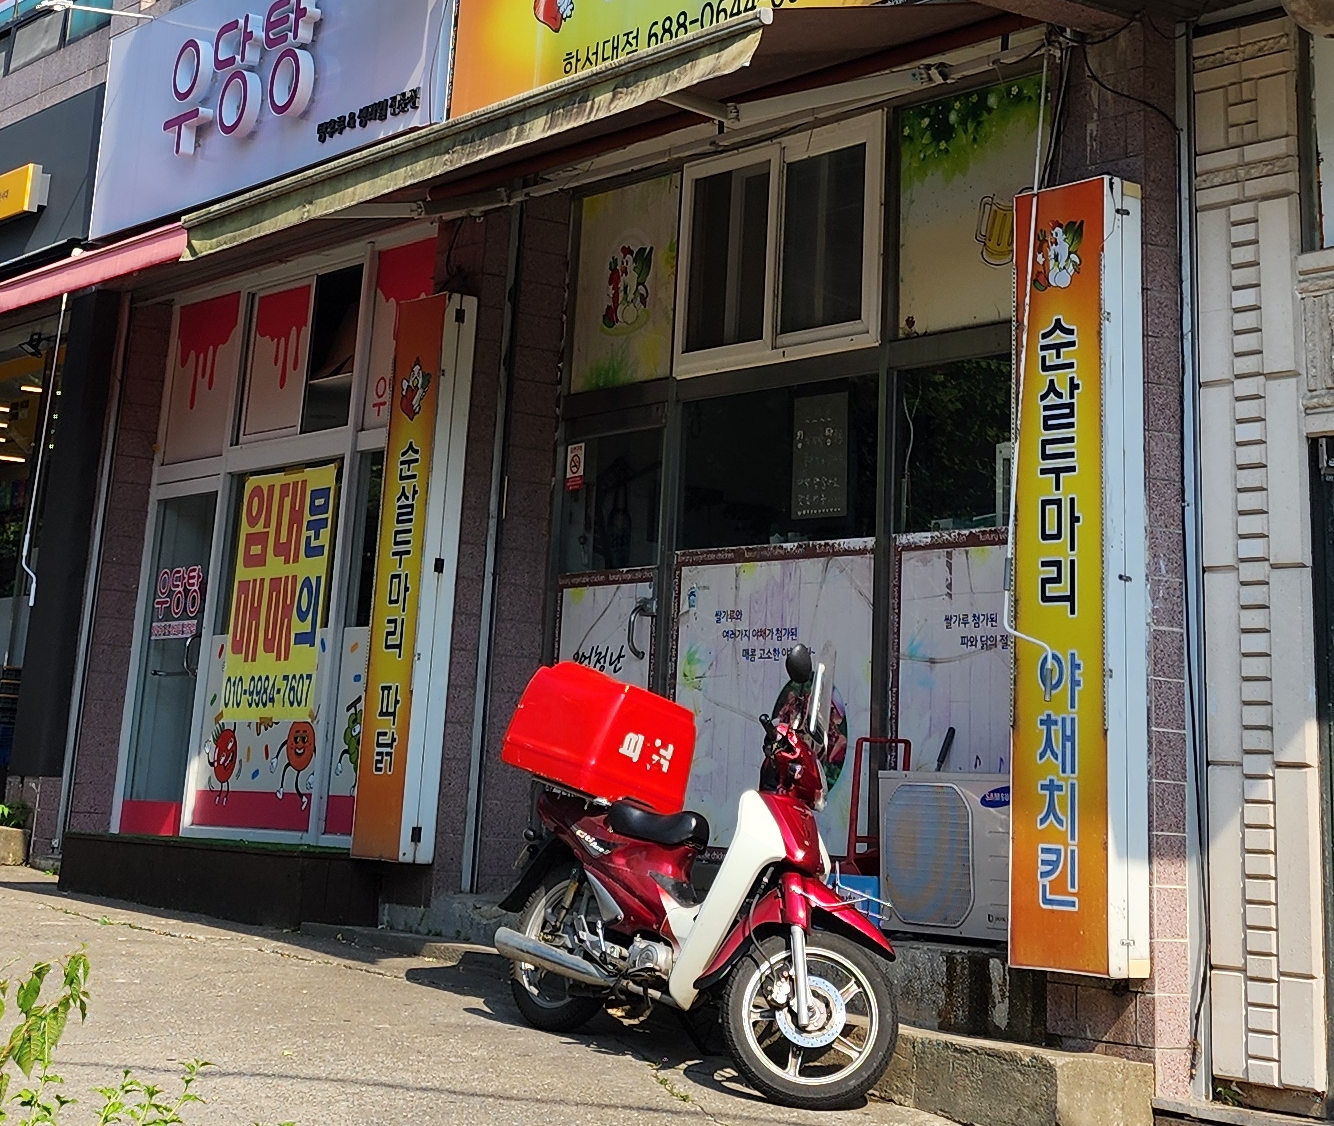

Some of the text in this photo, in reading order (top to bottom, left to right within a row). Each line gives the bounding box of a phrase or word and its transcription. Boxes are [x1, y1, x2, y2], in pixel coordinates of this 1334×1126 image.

[1037, 316, 1083, 618] 순살두마리
[244, 478, 308, 568] 임대
[382, 440, 423, 660] 순살두마리
[154, 564, 203, 619] 우당탕
[231, 574, 298, 664] 매매
[714, 609, 743, 624] 쌀가루와
[722, 628, 751, 642] 여러가지
[775, 627, 799, 642] 첨가된
[944, 612, 998, 629] 쌀가루 첨가된
[959, 635, 979, 649] 파와
[998, 634, 1011, 650] 절
[757, 647, 781, 661] 고소한
[223, 673, 314, 710] 010-9984-7607
[373, 685, 403, 775] 파닭
[1037, 648, 1085, 912] 야채치킨
